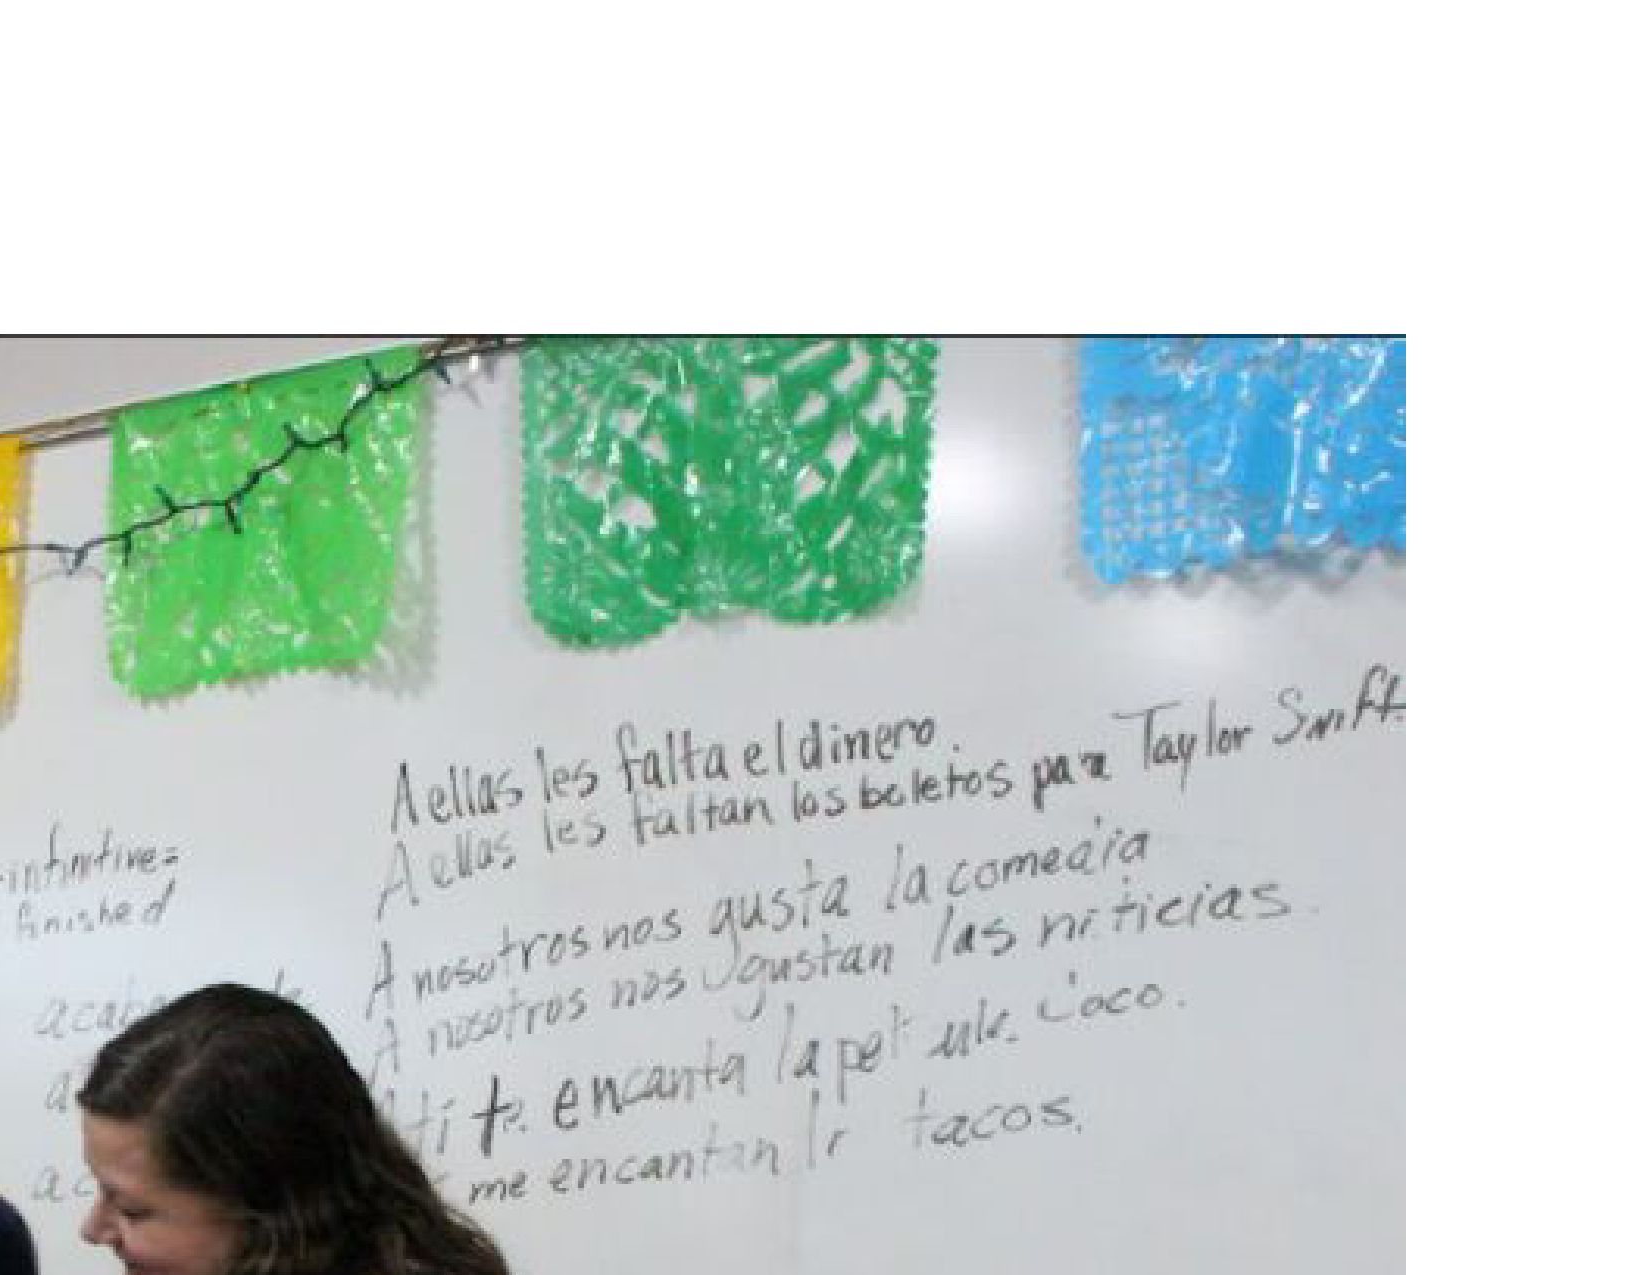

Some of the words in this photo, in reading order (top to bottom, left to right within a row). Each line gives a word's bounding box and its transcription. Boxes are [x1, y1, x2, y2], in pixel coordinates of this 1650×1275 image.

[377, 840, 419, 921] A
[429, 829, 518, 889] ellas
[543, 807, 607, 854] les
[791, 779, 848, 823] los
[859, 759, 1014, 810] boletos
[1110, 697, 1254, 794] Taylor
[426, 762, 524, 824] ellas
[536, 746, 599, 806] les
[616, 721, 729, 795] falta
[365, 940, 395, 1020] A
[413, 924, 591, 1000] nosotros
[603, 907, 682, 953] nos
[702, 858, 850, 992] gusta
[428, 985, 588, 1058] nosotros
[612, 964, 688, 1010] nos
[734, 933, 894, 1022] gustan
[932, 904, 1017, 965] las
[552, 1039, 747, 1131] encanta
[550, 1122, 780, 1196] encantan
